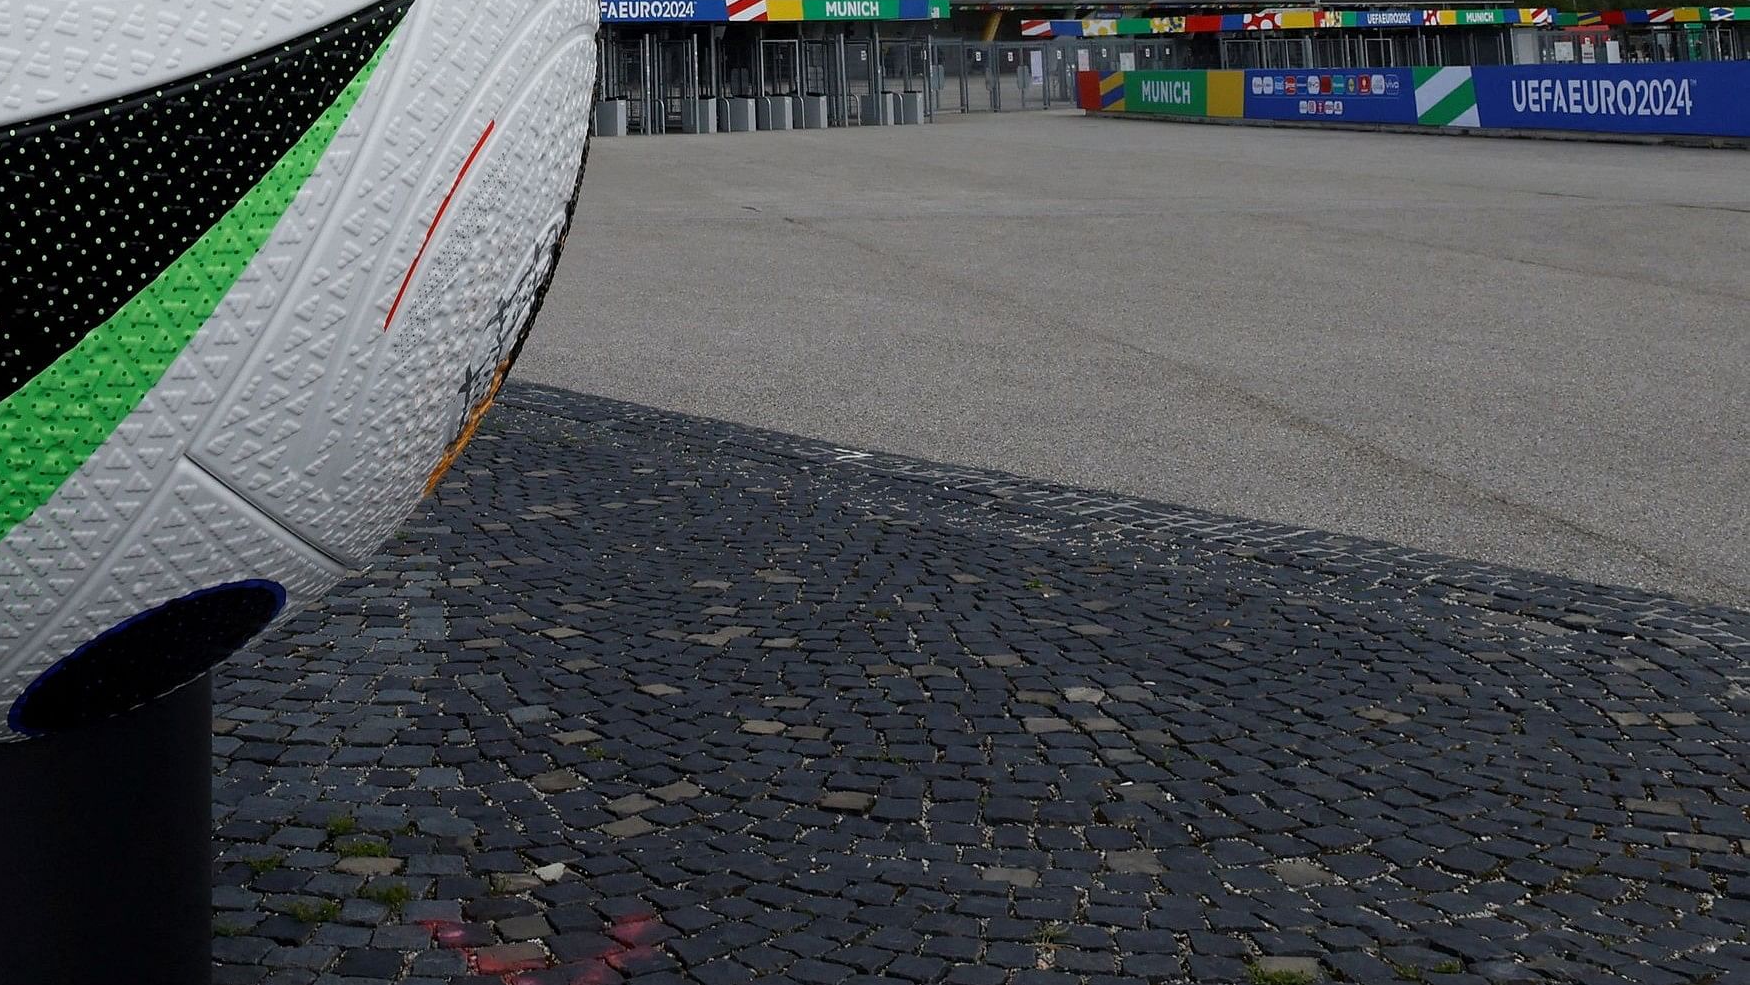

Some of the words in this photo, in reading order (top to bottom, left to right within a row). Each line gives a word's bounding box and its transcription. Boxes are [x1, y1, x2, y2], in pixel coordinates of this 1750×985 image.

[825, 0, 880, 17] MUNICH
[1465, 11, 1494, 23] MUNICH
[1141, 80, 1191, 104] MUNICH
